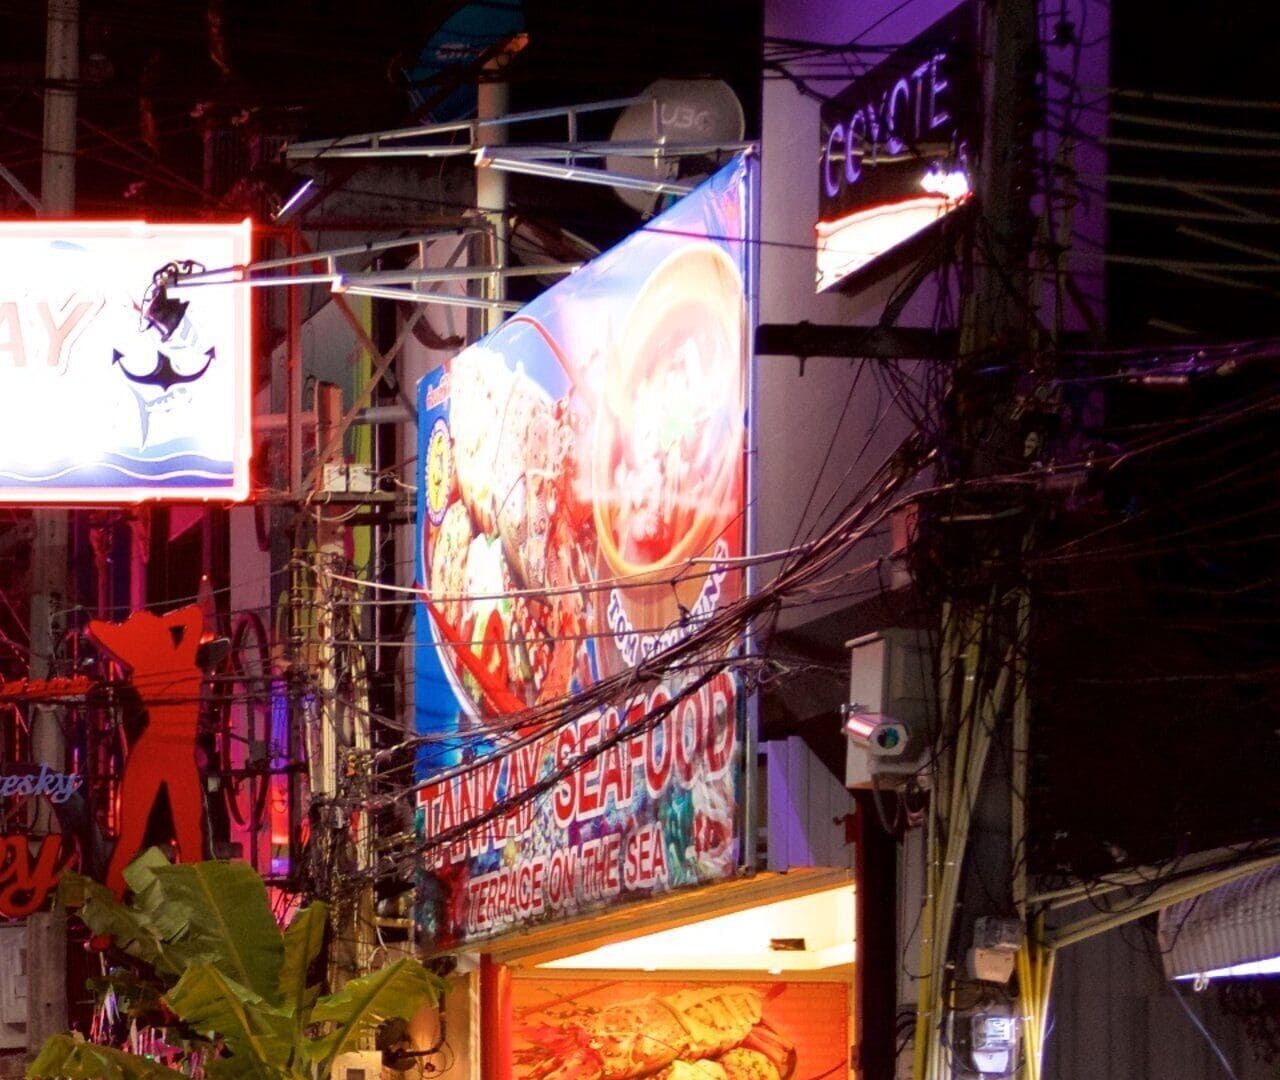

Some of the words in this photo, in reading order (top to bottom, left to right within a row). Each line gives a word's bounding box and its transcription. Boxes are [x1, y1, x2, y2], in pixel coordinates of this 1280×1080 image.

[554, 671, 738, 828] SEAFOOD
[467, 860, 545, 935] TERRACE
[548, 850, 579, 902] ON
[580, 829, 621, 895] THE
[624, 821, 669, 891] SEA
